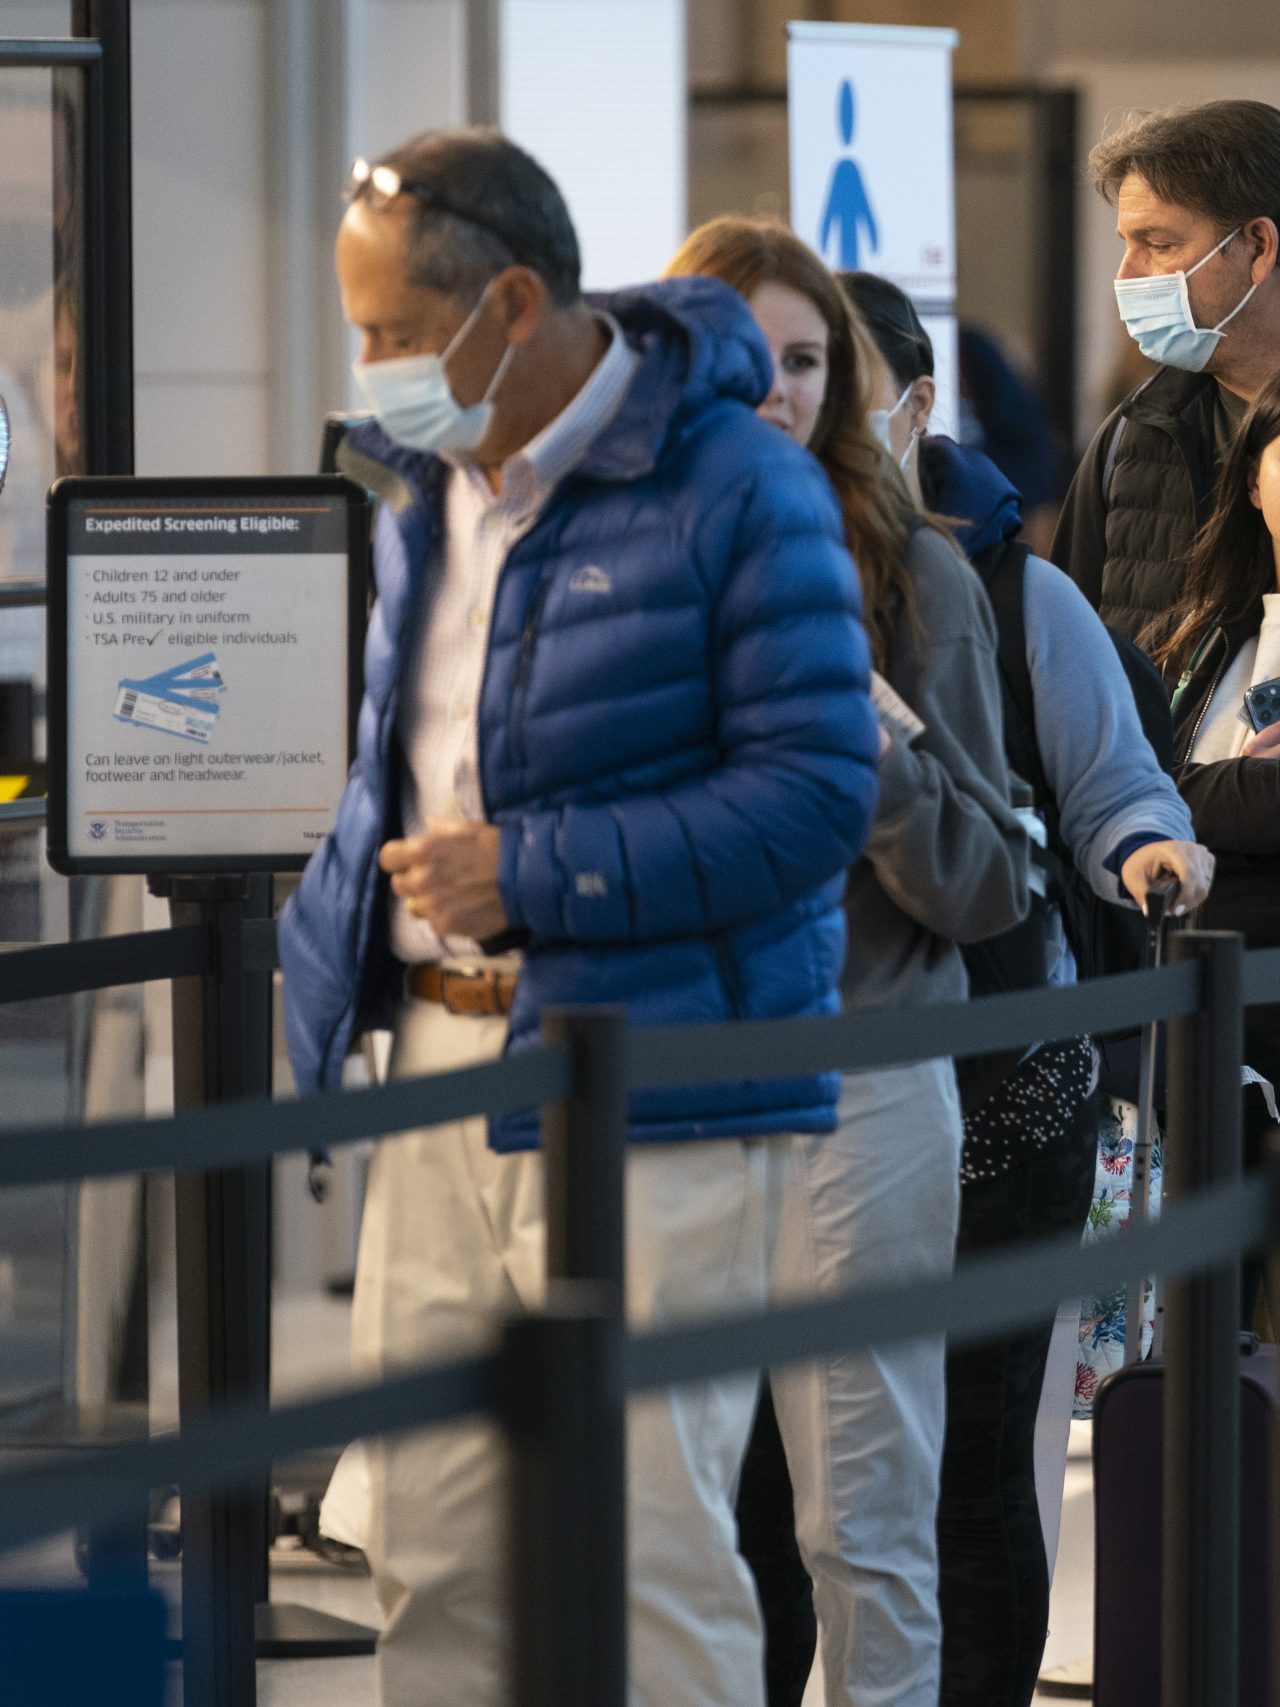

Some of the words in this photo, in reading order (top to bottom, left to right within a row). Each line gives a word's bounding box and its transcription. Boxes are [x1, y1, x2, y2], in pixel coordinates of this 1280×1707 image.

[86, 517, 161, 533] Expedited
[164, 517, 236, 534] Screening
[240, 516, 300, 533] Eligible:
[93, 570, 148, 582] Children
[154, 570, 168, 582] 12
[173, 570, 197, 582] and
[202, 569, 240, 581] under
[93, 590, 136, 603] Adults
[141, 591, 157, 603] 75
[162, 591, 187, 603] and
[191, 590, 227, 603] older
[93, 612, 116, 625] U.S.
[122, 611, 175, 626] military
[180, 611, 191, 624] in
[196, 611, 250, 624] uniform
[93, 633, 117, 646] TSA
[168, 631, 218, 647] eligible
[222, 631, 298, 645] individuals
[86, 753, 110, 766] Can
[114, 753, 149, 766] leave
[154, 755, 170, 765] on
[175, 752, 203, 767] light
[86, 769, 145, 782] footwear
[150, 769, 174, 782] and
